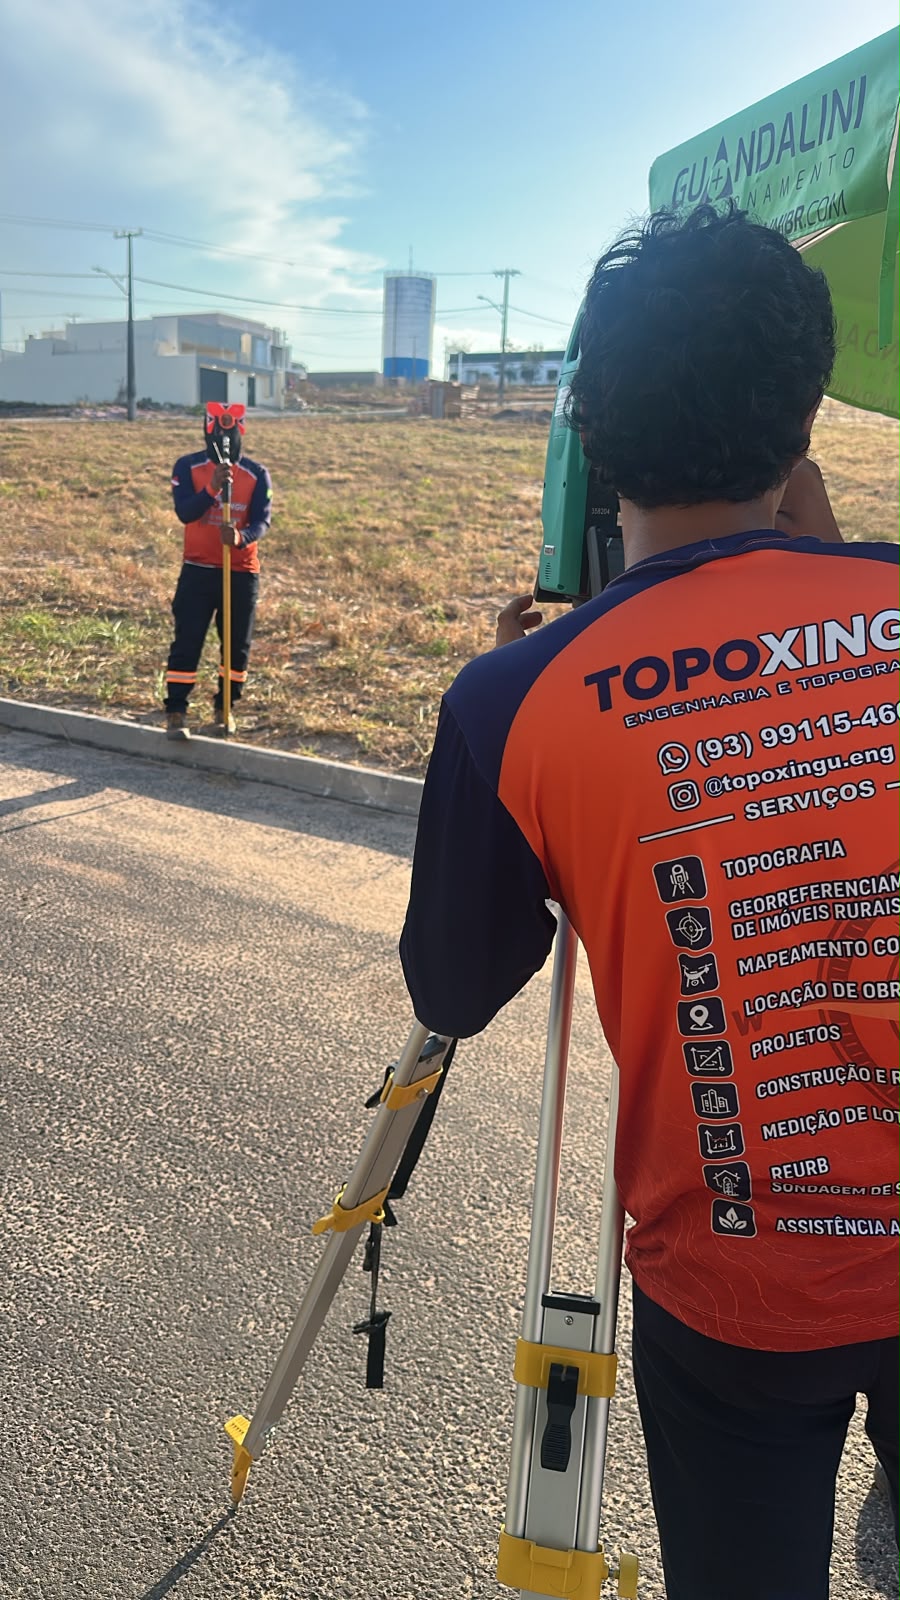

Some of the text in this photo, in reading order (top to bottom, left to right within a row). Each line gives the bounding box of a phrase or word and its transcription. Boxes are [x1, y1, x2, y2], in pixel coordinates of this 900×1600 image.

[624, 686, 770, 728] ENGENHARIA
[777, 682, 792, 695] E
[696, 701, 900, 766] (93) 99115-46
[705, 745, 894, 797] @topoxingu.eng
[744, 780, 876, 820] SERVIÇOS
[722, 839, 846, 879] TOPOGRAFIA
[733, 898, 900, 939] DE IMÓVEIS RURAIS
[738, 939, 868, 976] MAPEAMENTO
[744, 981, 900, 1016] LOCAÇÃO DE OBR
[751, 1024, 841, 1059] PROJETOS
[756, 1064, 871, 1098] CONSTRUÇÃO
[875, 1068, 887, 1084] E
[762, 1110, 841, 1140] MEDIÇÃO
[844, 1106, 868, 1123] DE
[770, 1157, 829, 1180] REURB
[771, 1181, 866, 1195] SONDAGEM
[871, 1184, 892, 1195] DE
[777, 1216, 887, 1236] ASSISTÊNCIA
